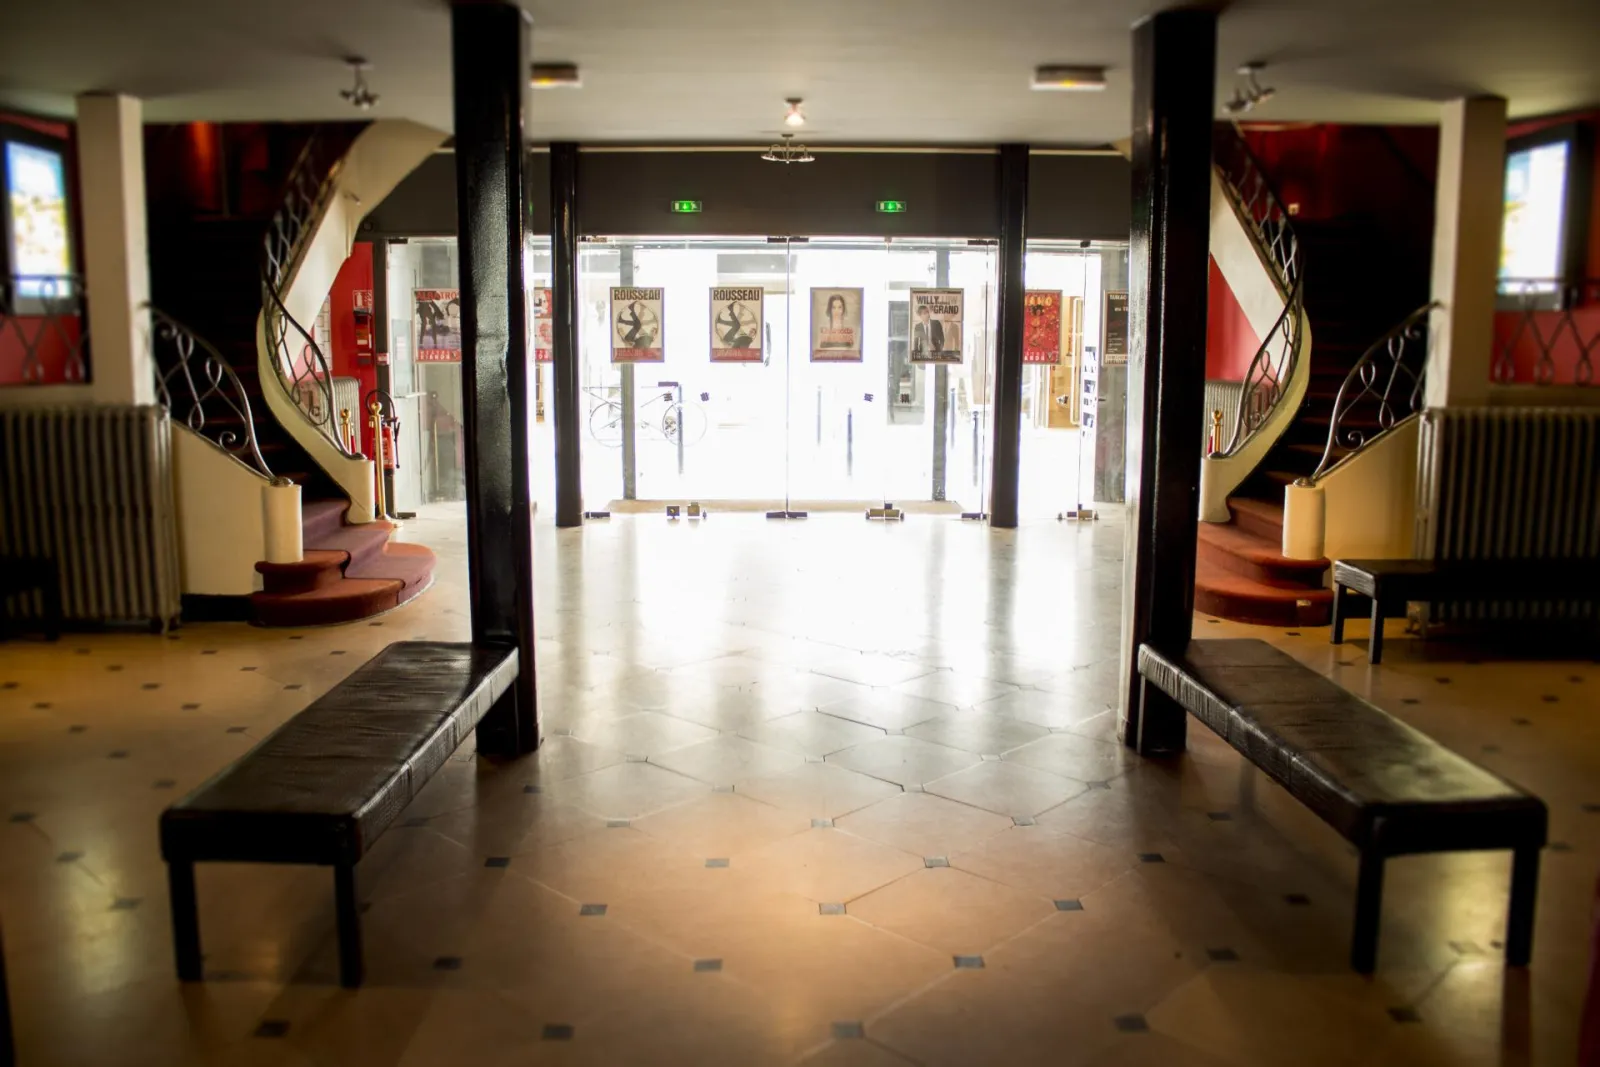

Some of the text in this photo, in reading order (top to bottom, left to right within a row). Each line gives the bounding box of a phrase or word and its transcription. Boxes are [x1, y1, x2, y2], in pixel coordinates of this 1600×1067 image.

[614, 289, 661, 301] ROUSSEAU
[713, 289, 760, 301] ROUSSEAU
[916, 295, 939, 305] WILLY
[933, 305, 959, 314] GRAND
